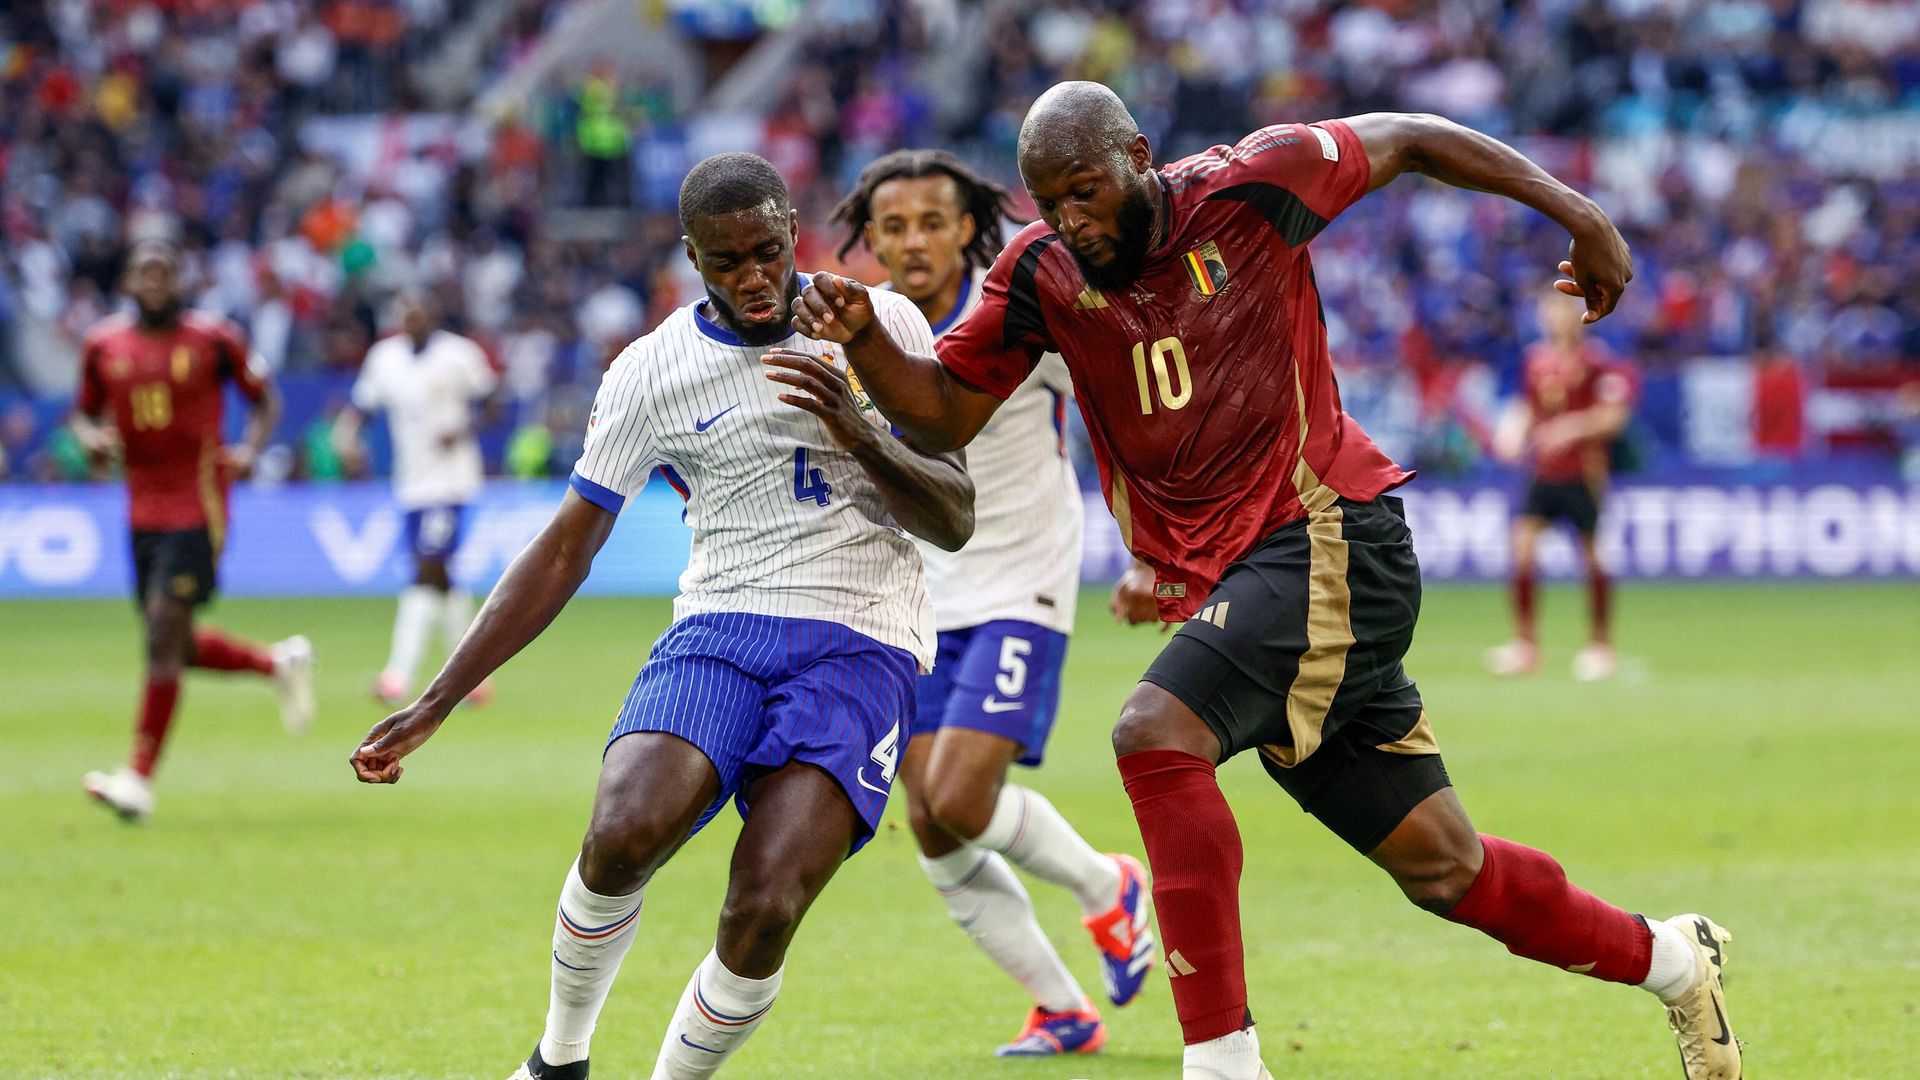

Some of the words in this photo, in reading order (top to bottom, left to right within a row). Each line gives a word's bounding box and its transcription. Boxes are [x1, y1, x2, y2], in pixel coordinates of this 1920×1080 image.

[1132, 336, 1192, 415] 10
[794, 447, 832, 507] 4
[995, 635, 1033, 699] 5
[870, 717, 899, 784] 4
